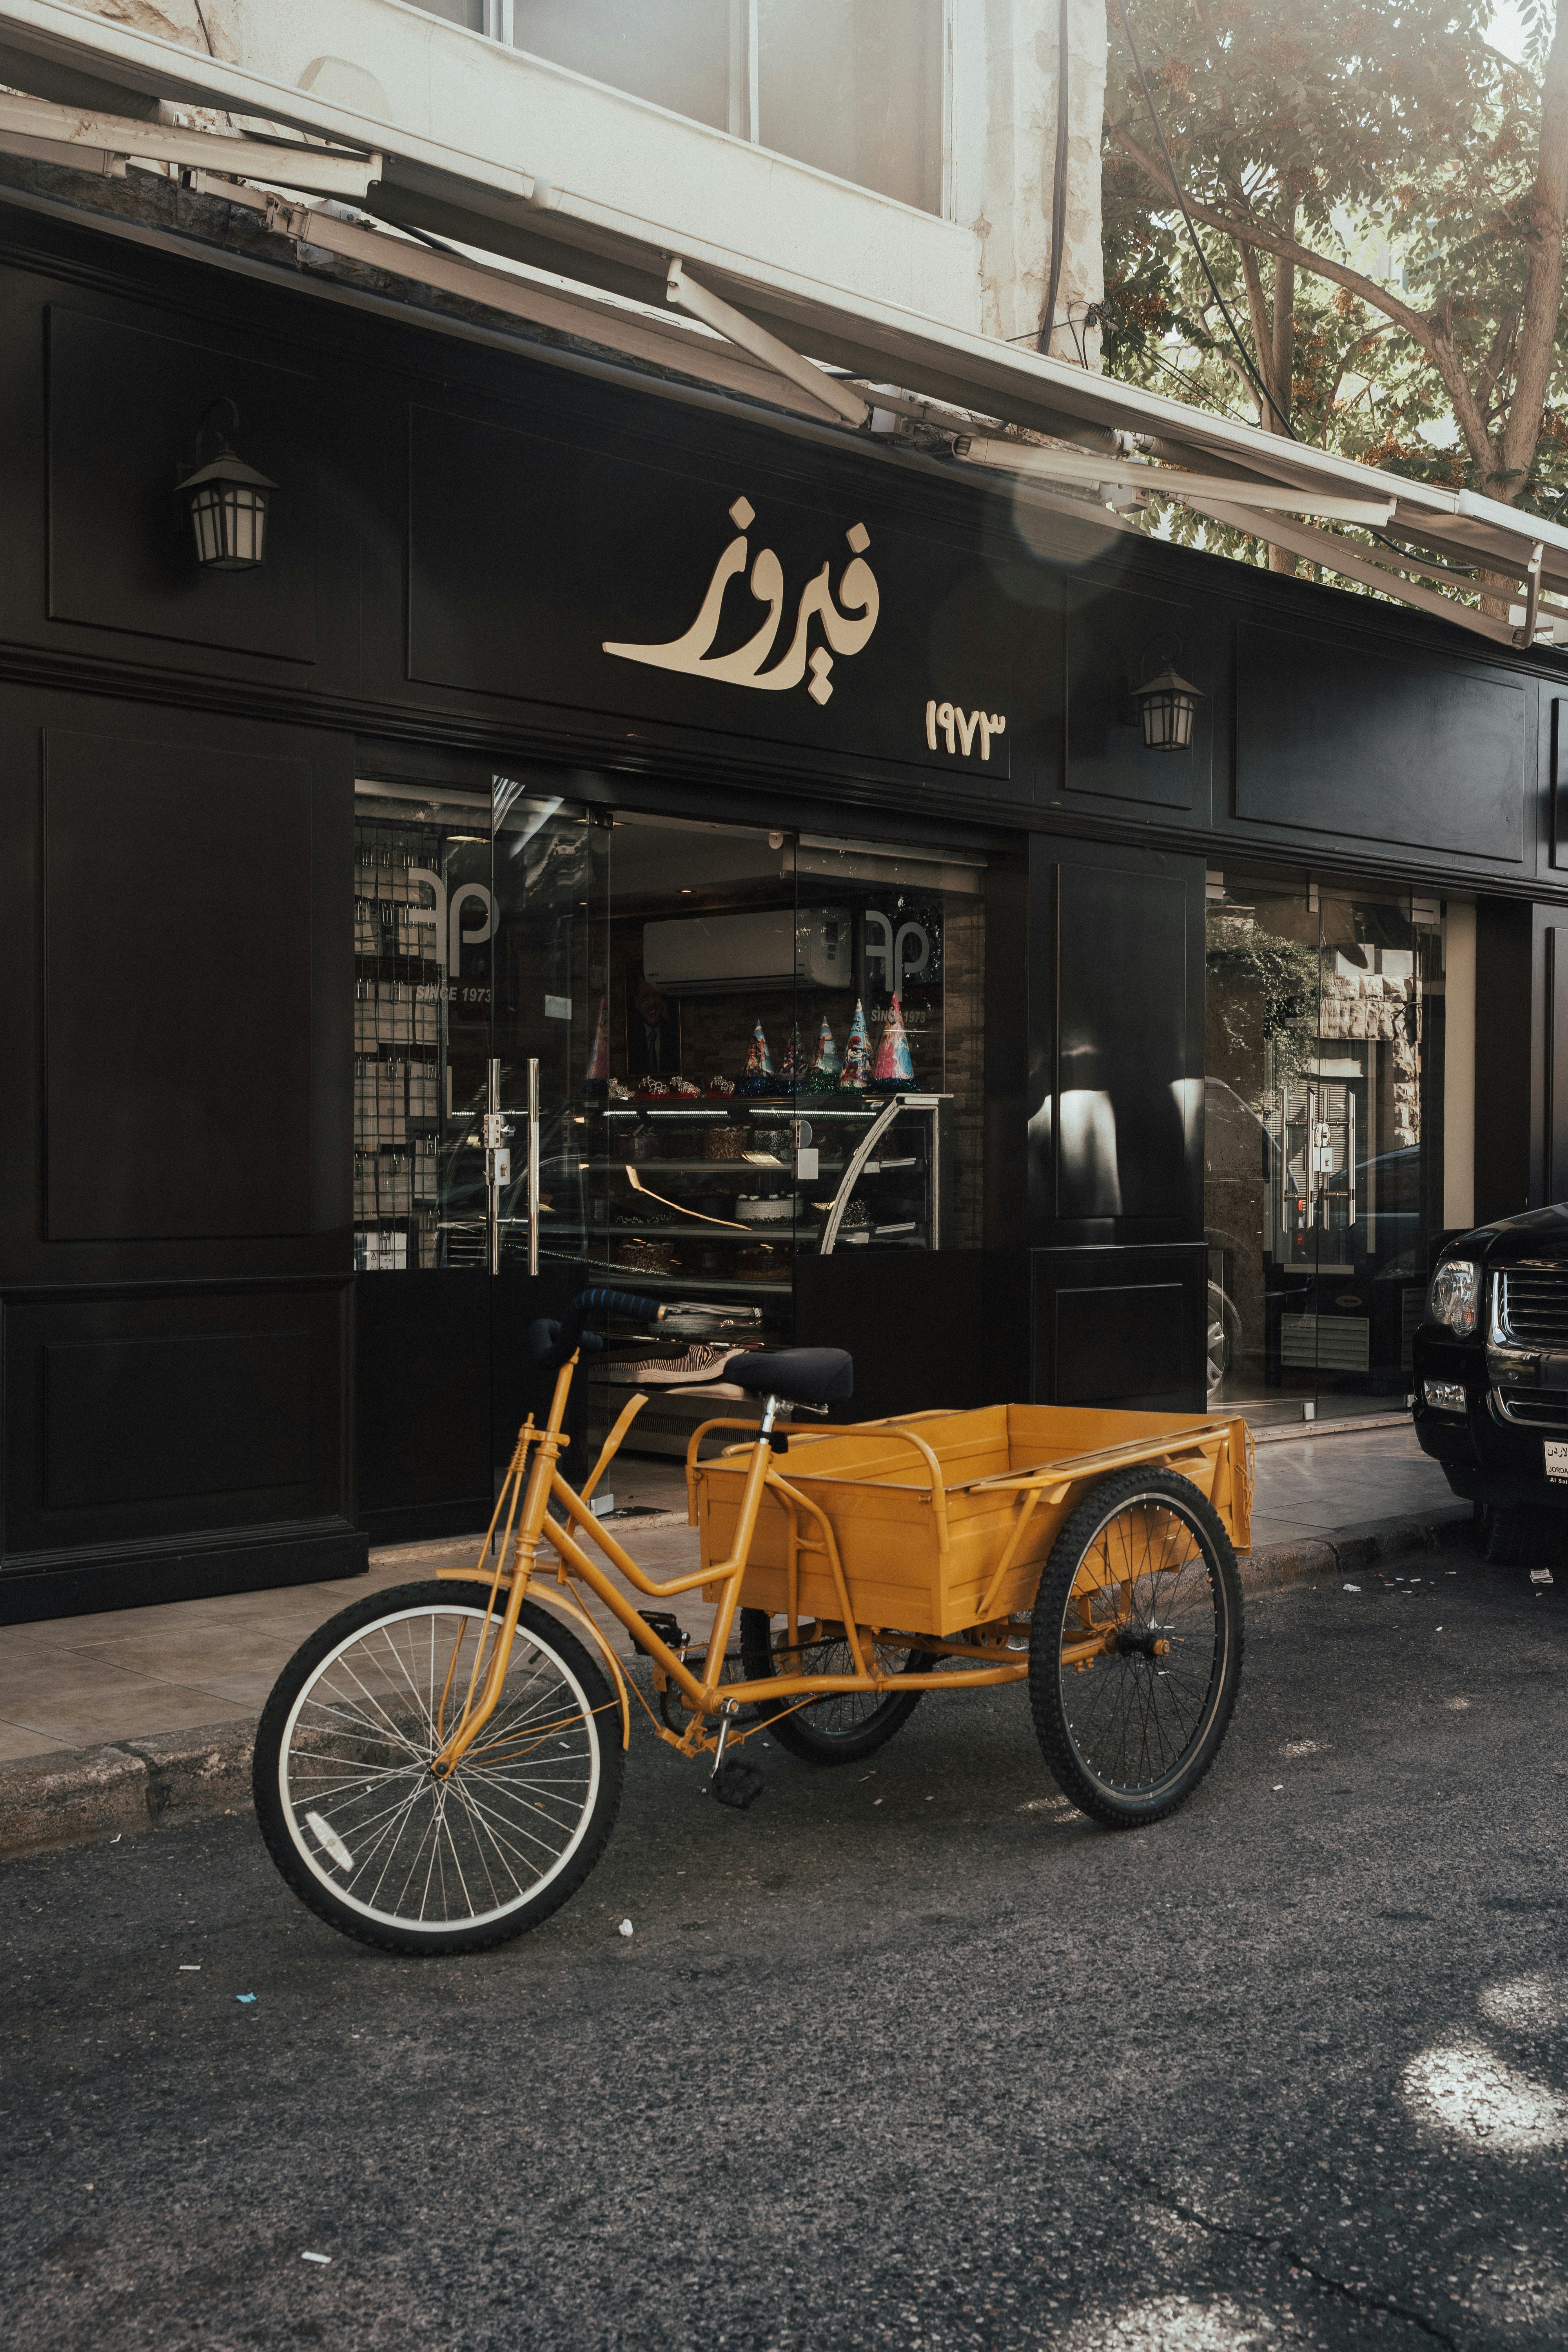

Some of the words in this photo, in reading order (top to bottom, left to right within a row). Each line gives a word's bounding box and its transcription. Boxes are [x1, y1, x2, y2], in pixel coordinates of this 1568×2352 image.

[602, 496, 880, 705] فيروز
[926, 700, 1006, 761] ١٩٧٣
[416, 985, 457, 1001] SINCE
[462, 987, 491, 1003] 1973
[904, 1011, 926, 1023] 1973
[1548, 1446, 1568, 1457] لاردن
[1549, 1466, 1568, 1474] JORDA
